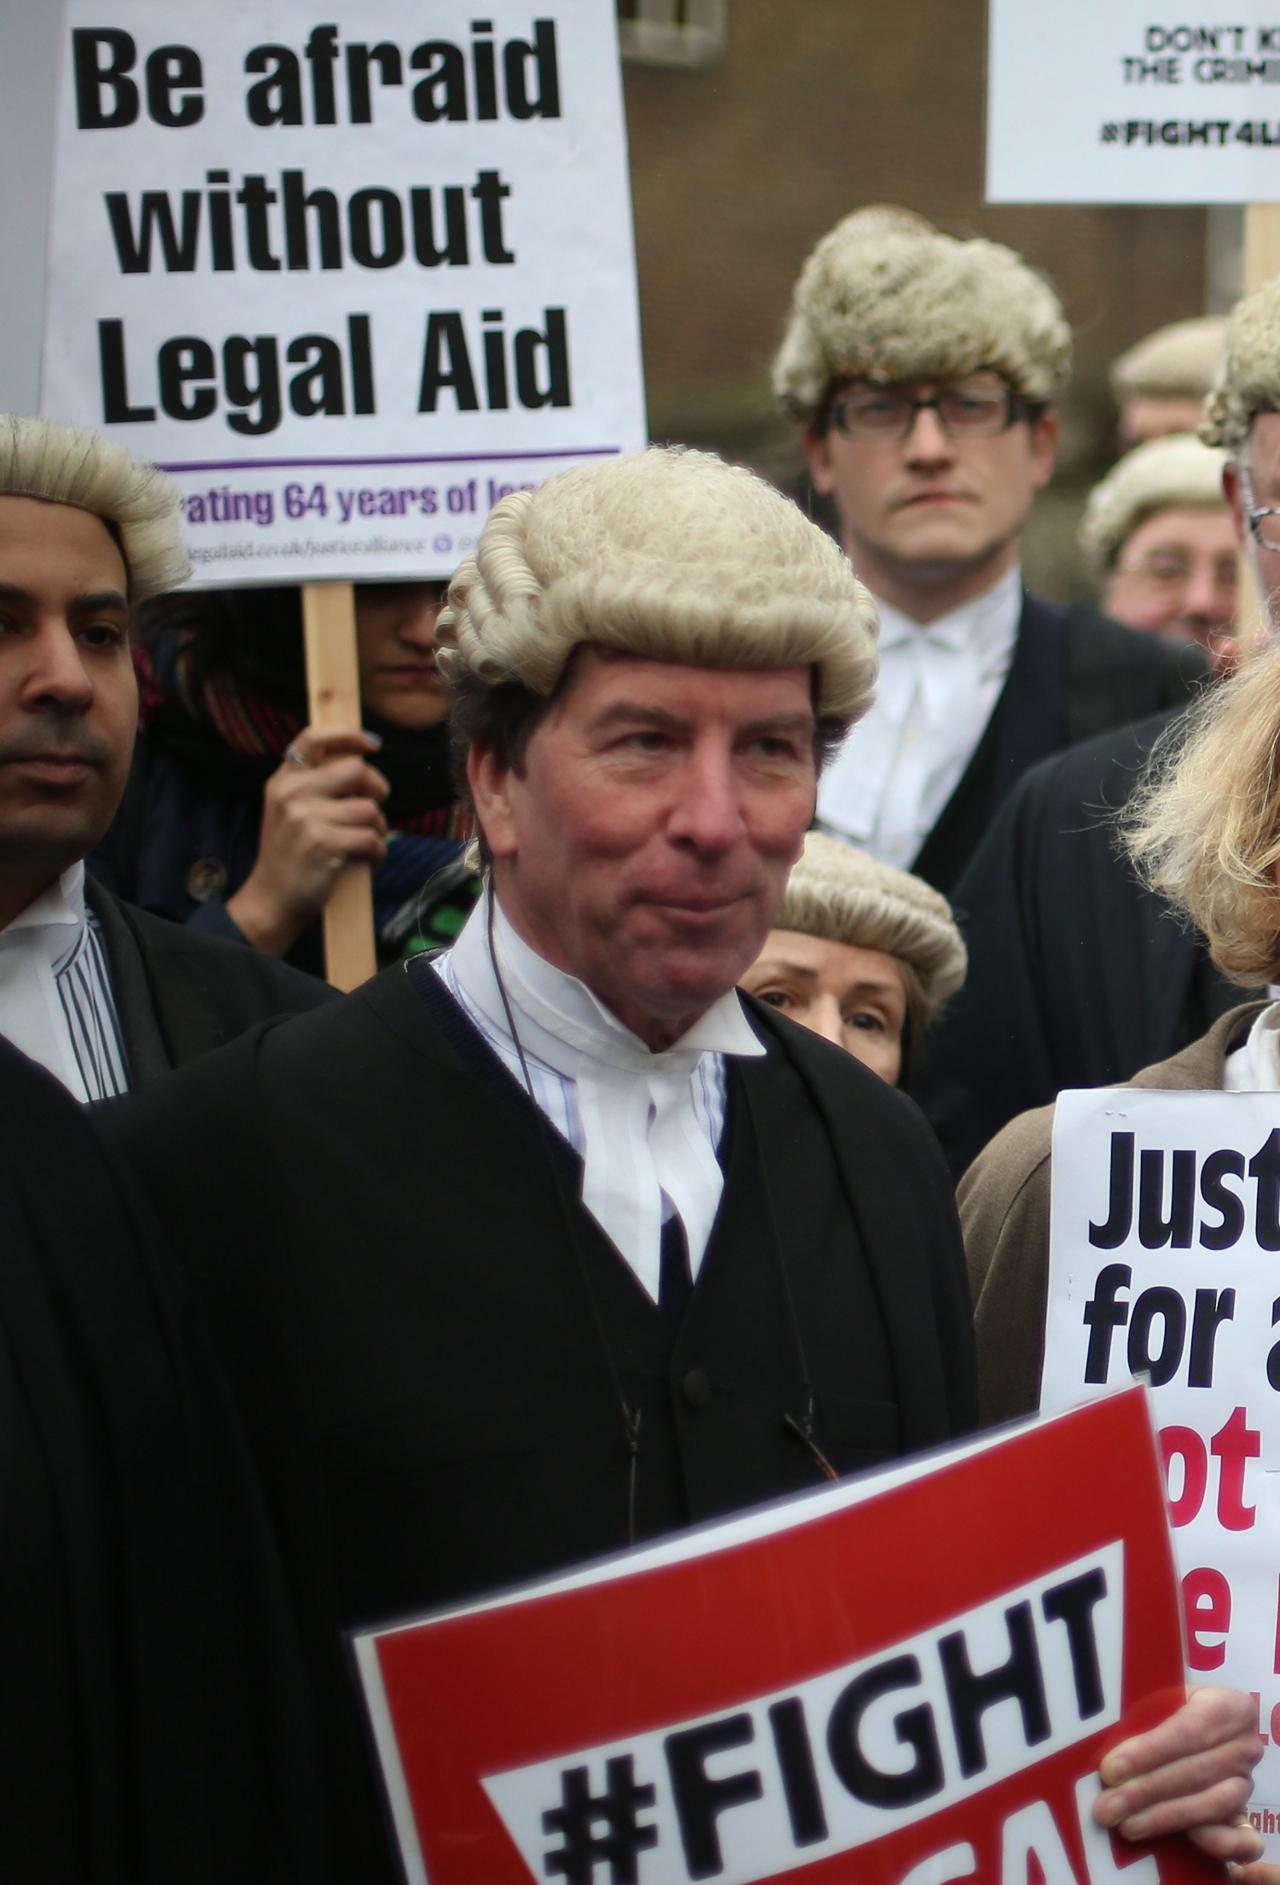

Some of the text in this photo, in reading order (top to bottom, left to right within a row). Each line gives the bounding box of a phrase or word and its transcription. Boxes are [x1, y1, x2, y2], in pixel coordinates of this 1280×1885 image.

[72, 19, 561, 130] Be afraid
[1122, 57, 1181, 84] THE
[1146, 26, 1246, 53] DON'T
[104, 169, 516, 275] without
[97, 308, 573, 436] Legal Aid
[183, 484, 274, 527] ating
[283, 483, 329, 520] 64
[336, 483, 439, 523] years
[446, 477, 477, 514] of
[1082, 1263, 1236, 1388] for
[1158, 1406, 1261, 1532] ot
[541, 1565, 1108, 1885] #FIGHT
